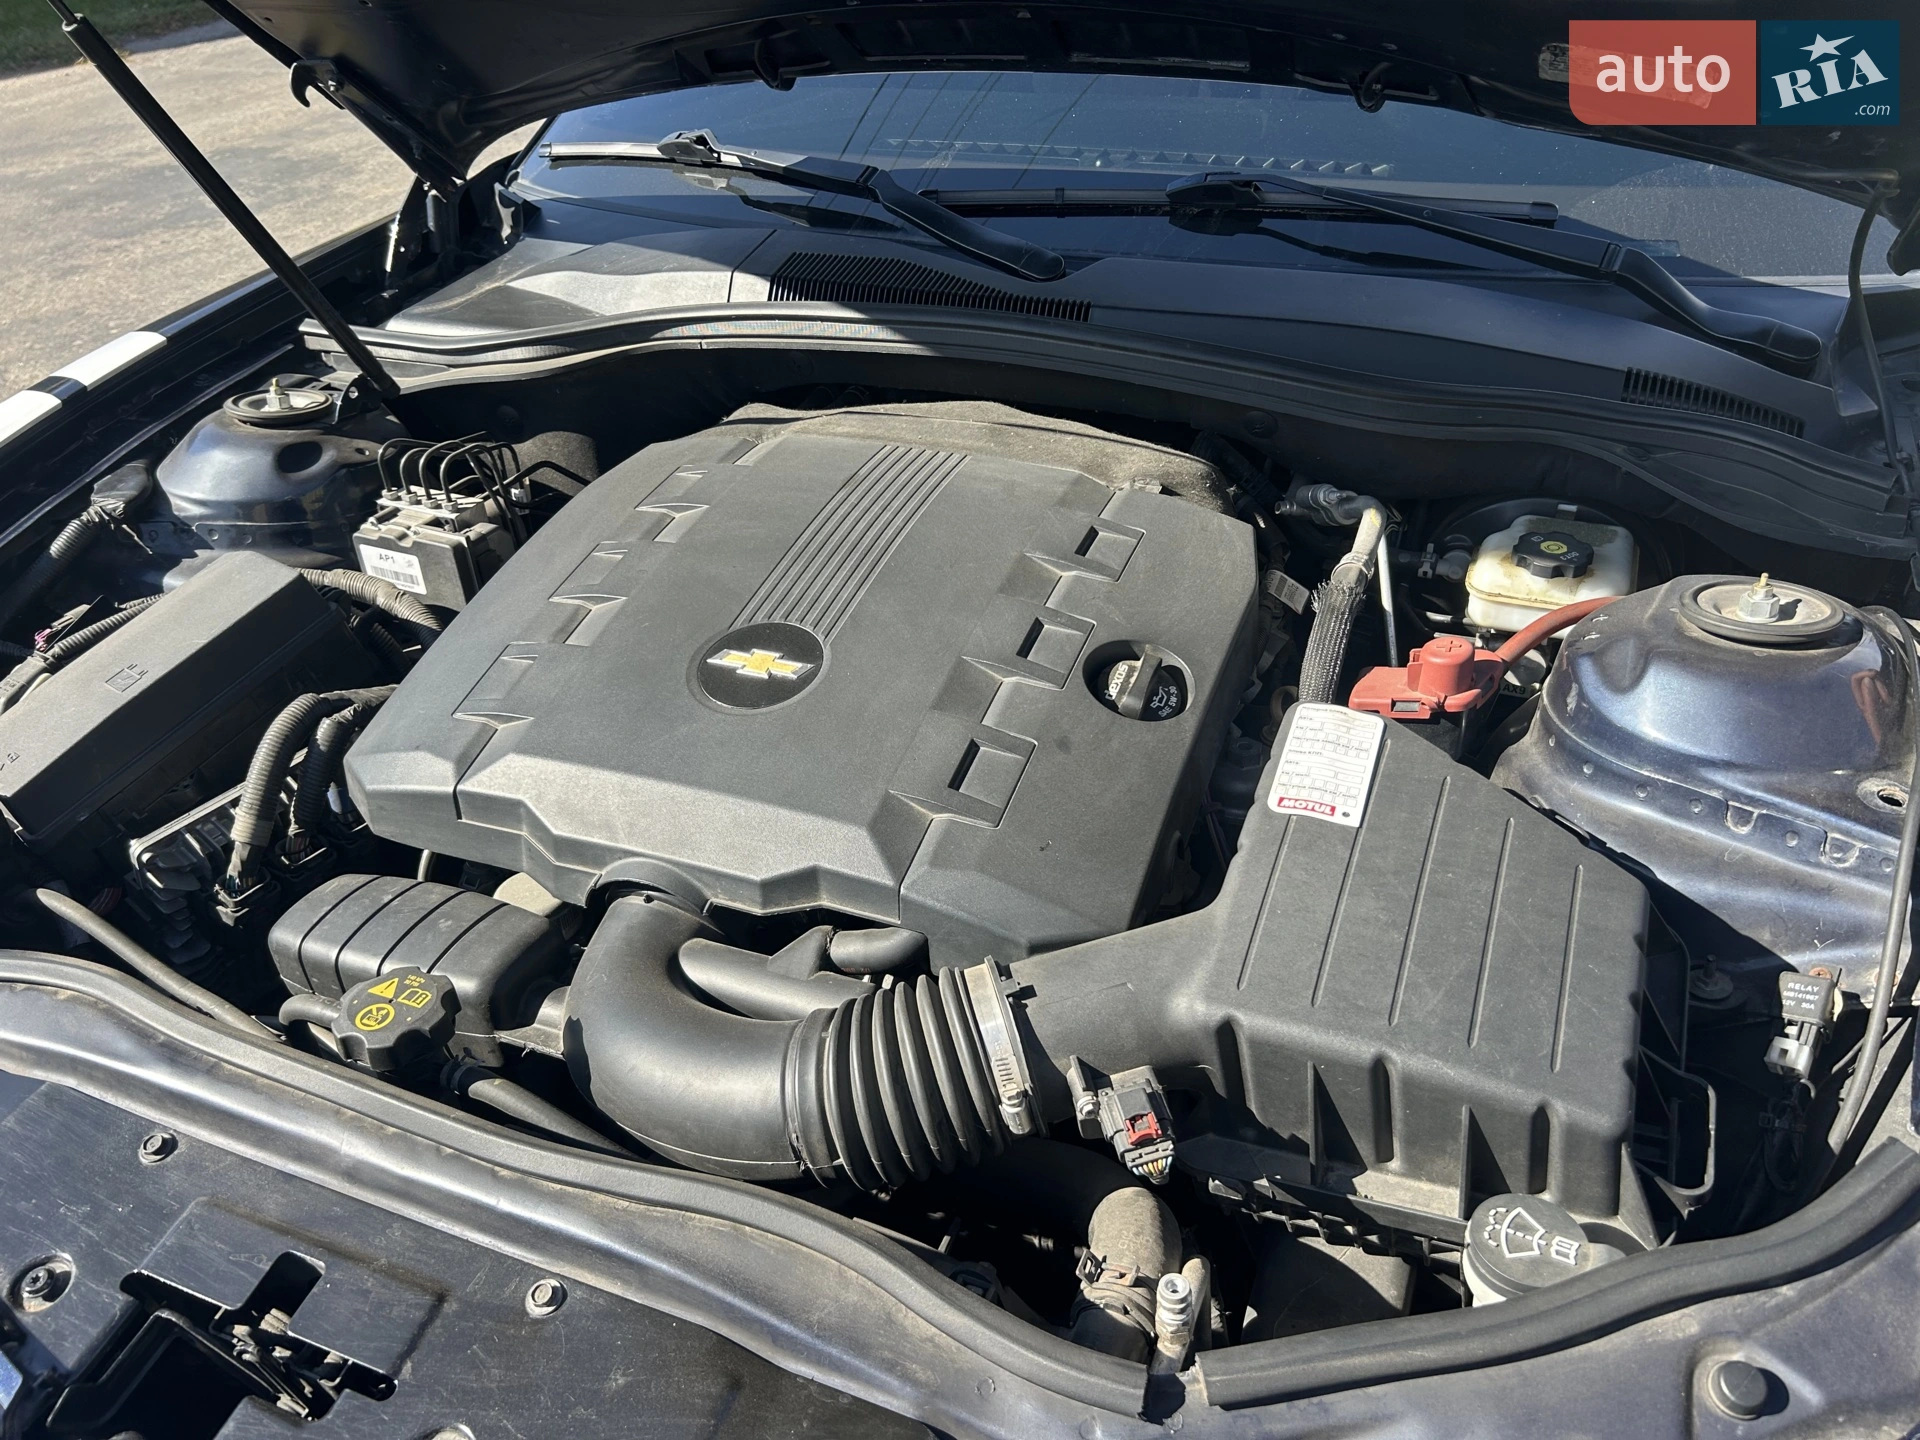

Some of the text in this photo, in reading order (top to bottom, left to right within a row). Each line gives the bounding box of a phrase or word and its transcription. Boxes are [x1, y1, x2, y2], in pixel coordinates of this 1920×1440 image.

[378, 553, 395, 564] AP1
[1104, 664, 1128, 700] dexos
[1502, 684, 1526, 695] AX9
[1158, 686, 1178, 718] SAE 5W-30
[1280, 799, 1334, 815] MOTUL
[1788, 982, 1820, 992] RELAY
